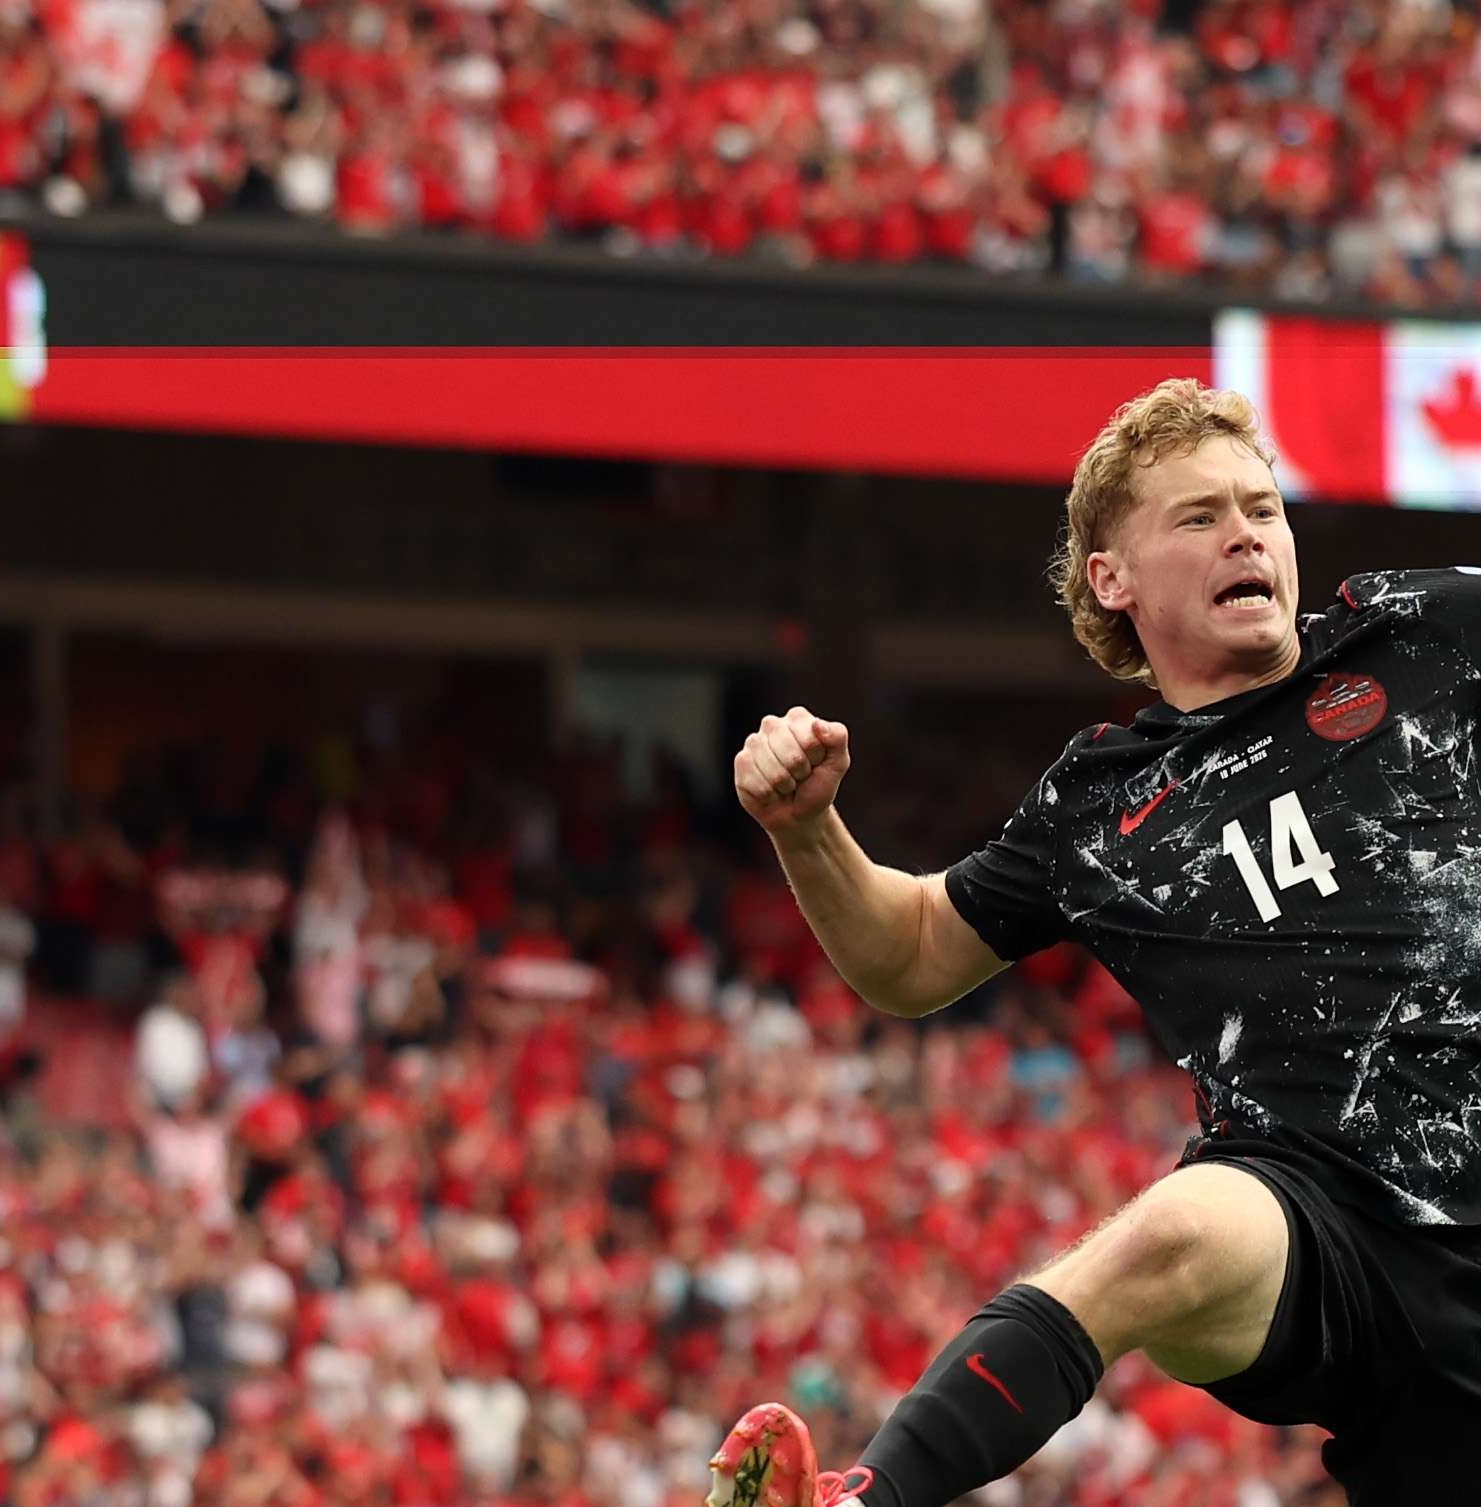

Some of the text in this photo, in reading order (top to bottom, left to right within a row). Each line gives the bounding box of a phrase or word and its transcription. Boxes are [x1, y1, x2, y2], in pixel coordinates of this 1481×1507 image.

[1313, 691, 1380, 724] CANADA
[1247, 736, 1273, 753] QATAR
[1222, 790, 1340, 923] 14
